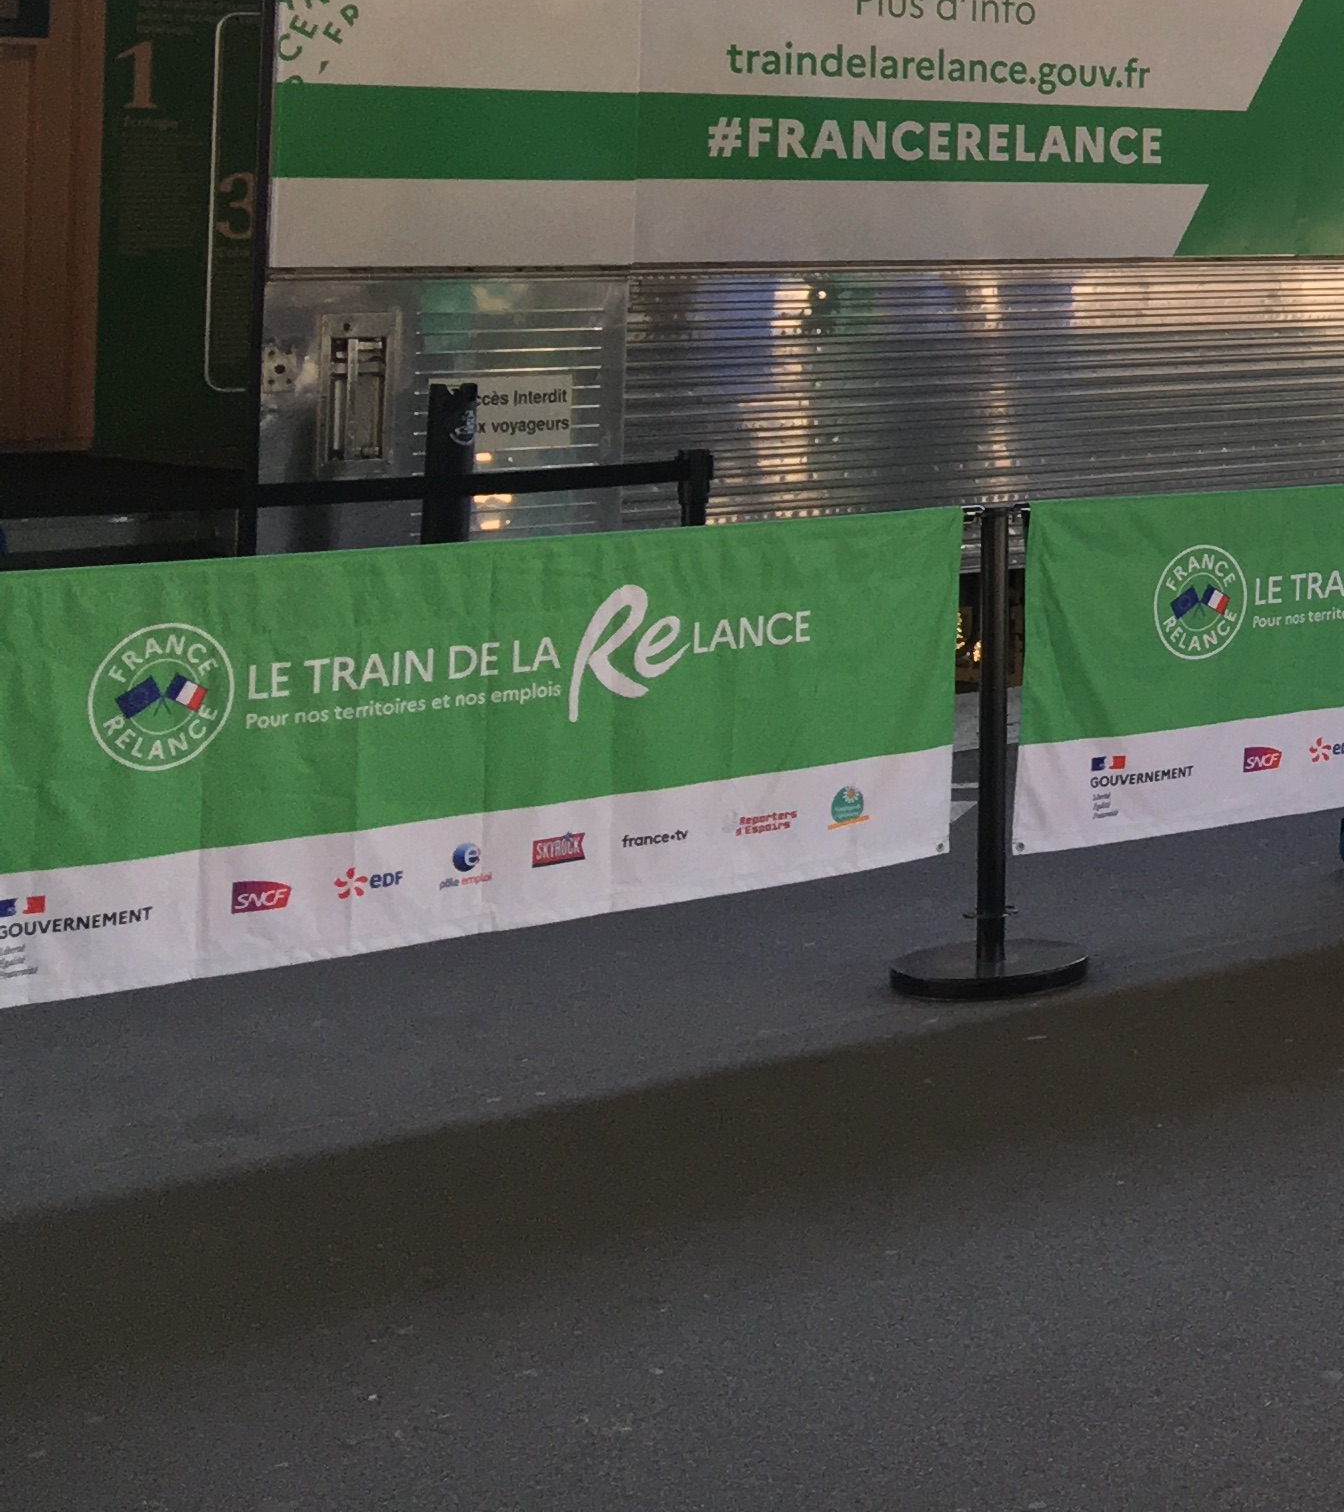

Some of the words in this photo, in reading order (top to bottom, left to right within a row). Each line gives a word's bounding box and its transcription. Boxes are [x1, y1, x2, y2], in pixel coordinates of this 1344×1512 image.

[726, 41, 1151, 95] traindelarelance.gouv.fr
[707, 116, 1163, 165] #FRANCERELANCE
[477, 390, 509, 406] ccès
[514, 389, 567, 407] Interdit
[490, 418, 570, 437] voyageurs
[1166, 553, 1237, 592] FRANCE
[1254, 575, 1283, 606] LE
[1162, 608, 1238, 652] RELANCE
[1252, 613, 1282, 630] Pour
[1285, 613, 1306, 626] nos
[107, 634, 219, 684] FRANCE
[247, 661, 292, 701] LE
[304, 647, 435, 695] TRAIN
[447, 641, 501, 681] DE
[512, 635, 561, 674] LA
[245, 711, 294, 730] Pour
[298, 707, 330, 724] nos
[333, 695, 426, 721] territoires
[431, 693, 451, 710] et
[455, 691, 486, 707] nos
[490, 680, 562, 706] emplois
[102, 704, 219, 760] RELANCE
[1089, 764, 1194, 789] GOUVERNEMENT
[1244, 752, 1281, 770] SNCF
[0, 905, 154, 940] GOUVERNEMENT
[234, 888, 288, 911] SNCF
[535, 835, 582, 862] SKYROCK
[438, 877, 460, 891] pôle
[460, 872, 493, 887] emploi
